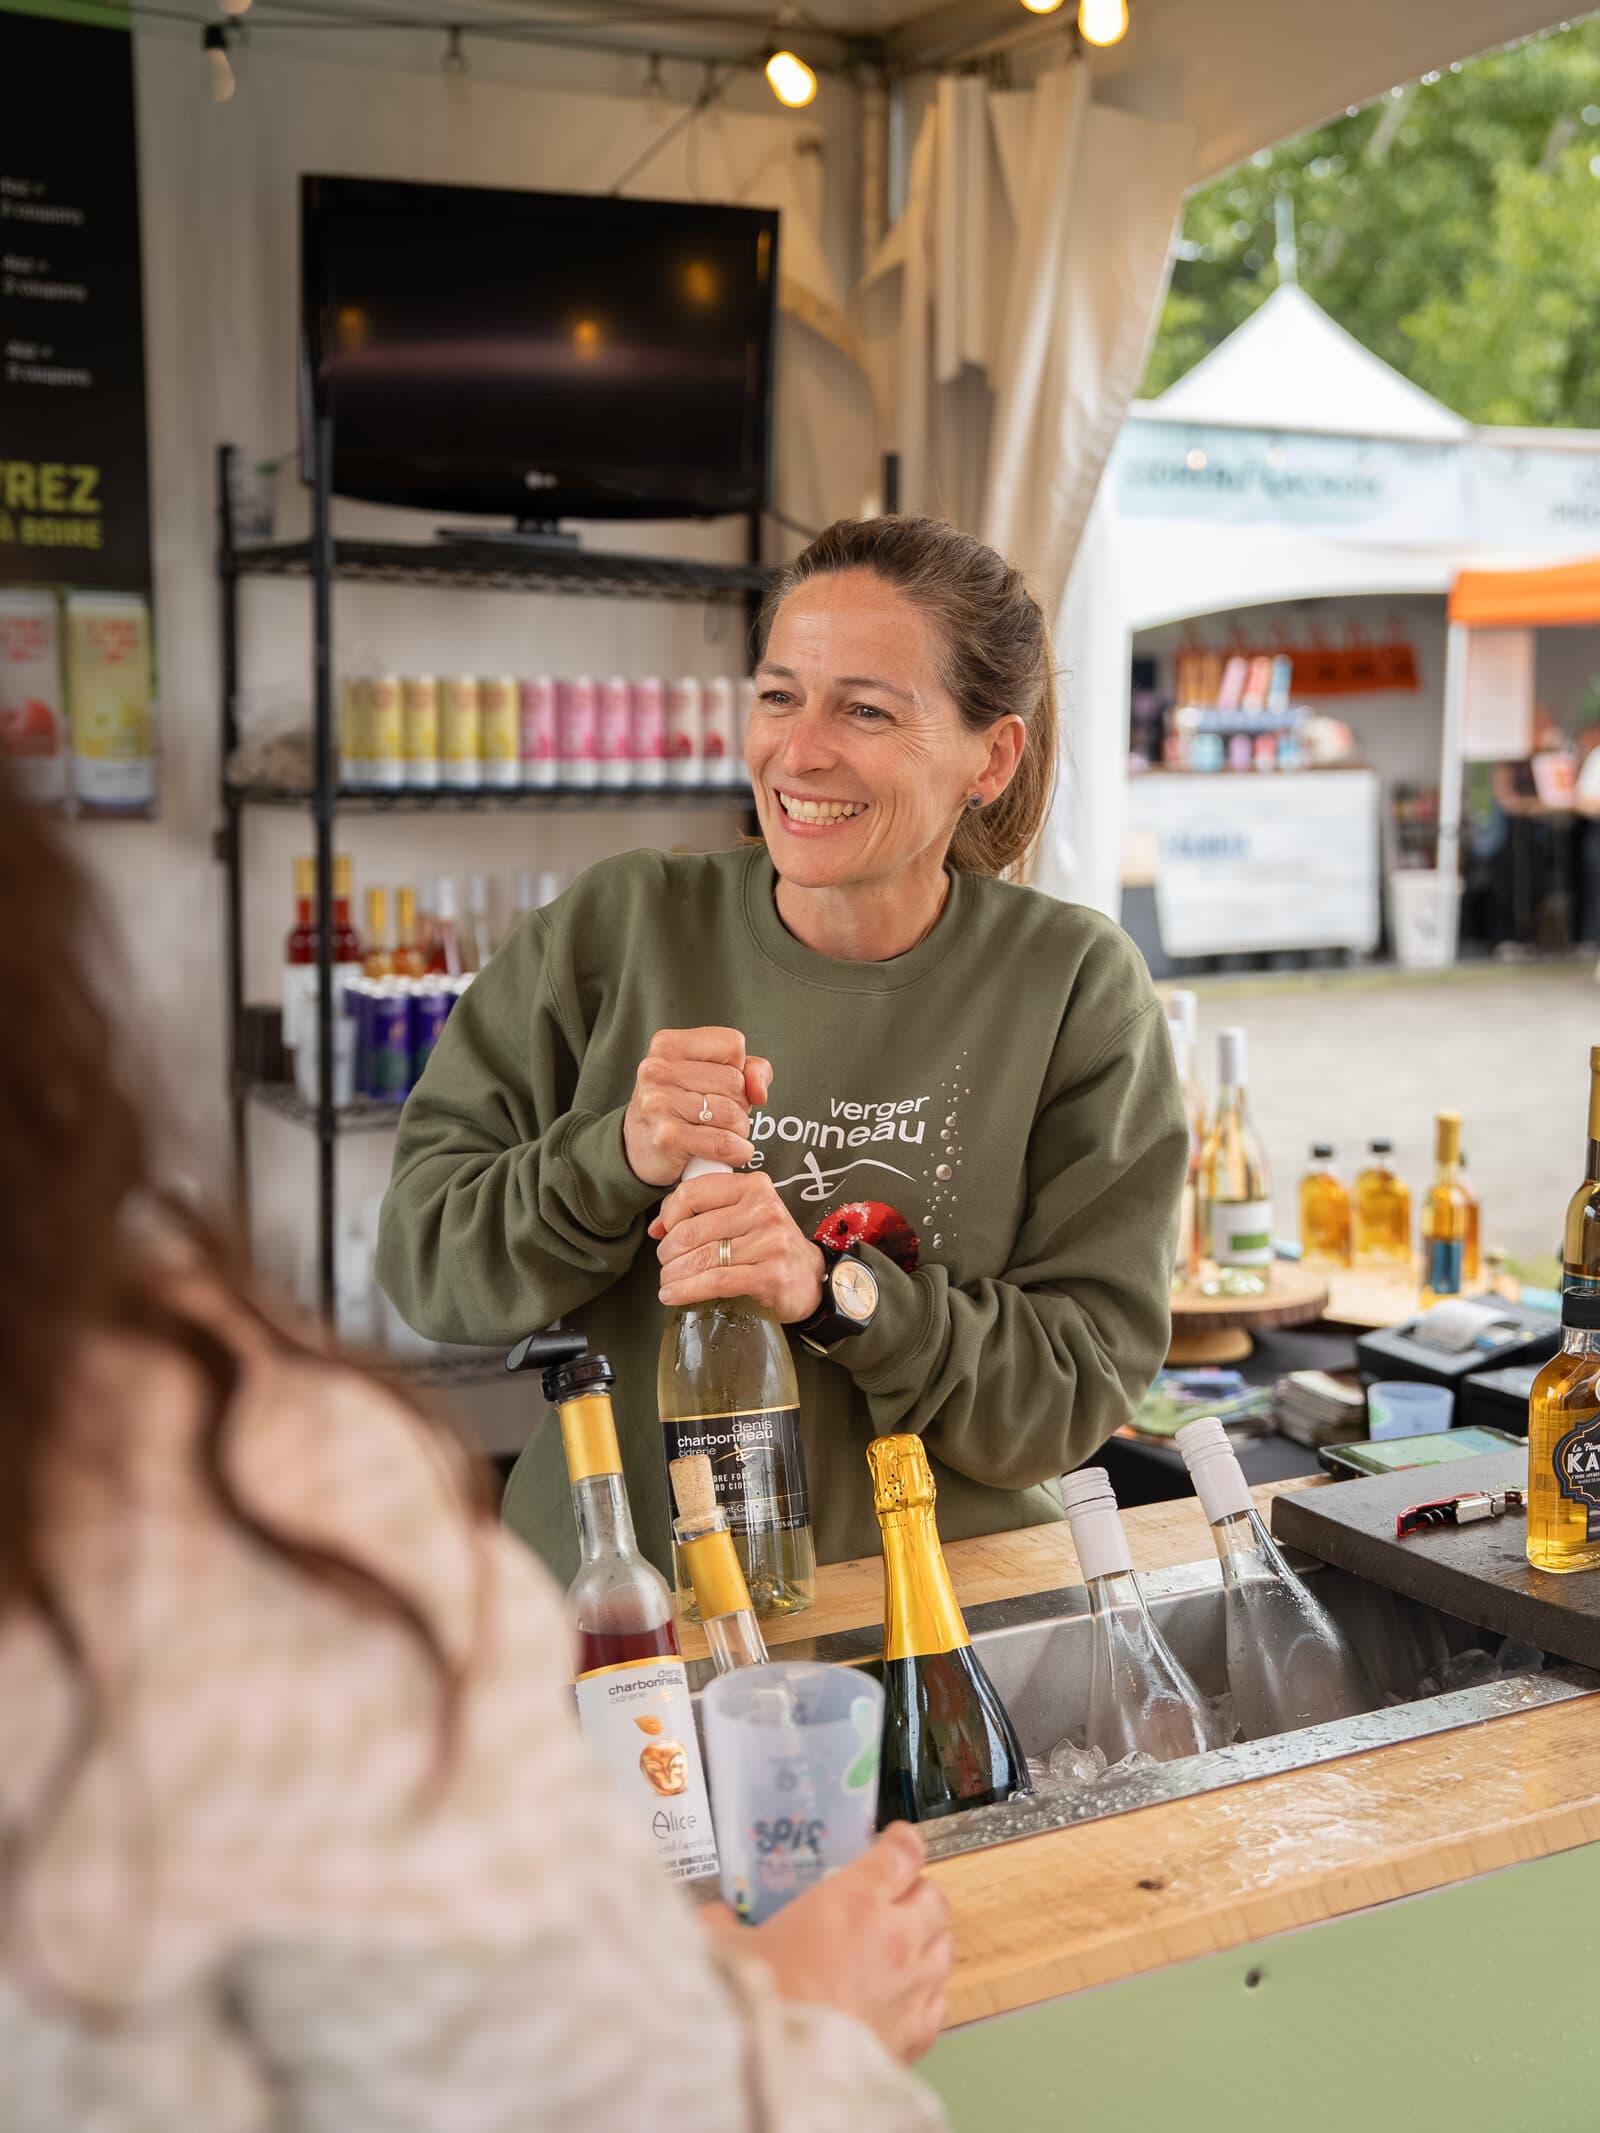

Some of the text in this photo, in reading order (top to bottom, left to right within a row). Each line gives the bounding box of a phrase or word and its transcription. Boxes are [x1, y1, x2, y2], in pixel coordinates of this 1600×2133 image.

[0, 461, 101, 512] REZ
[830, 1096, 931, 1122] verger
[749, 1112, 926, 1149] bonneau
[731, 1419, 773, 1433] denis
[677, 1429, 773, 1448] charbonneau
[657, 1669, 682, 1679] denis
[608, 1677, 683, 1696] charbonneau
[652, 1810, 697, 1840] Alice
